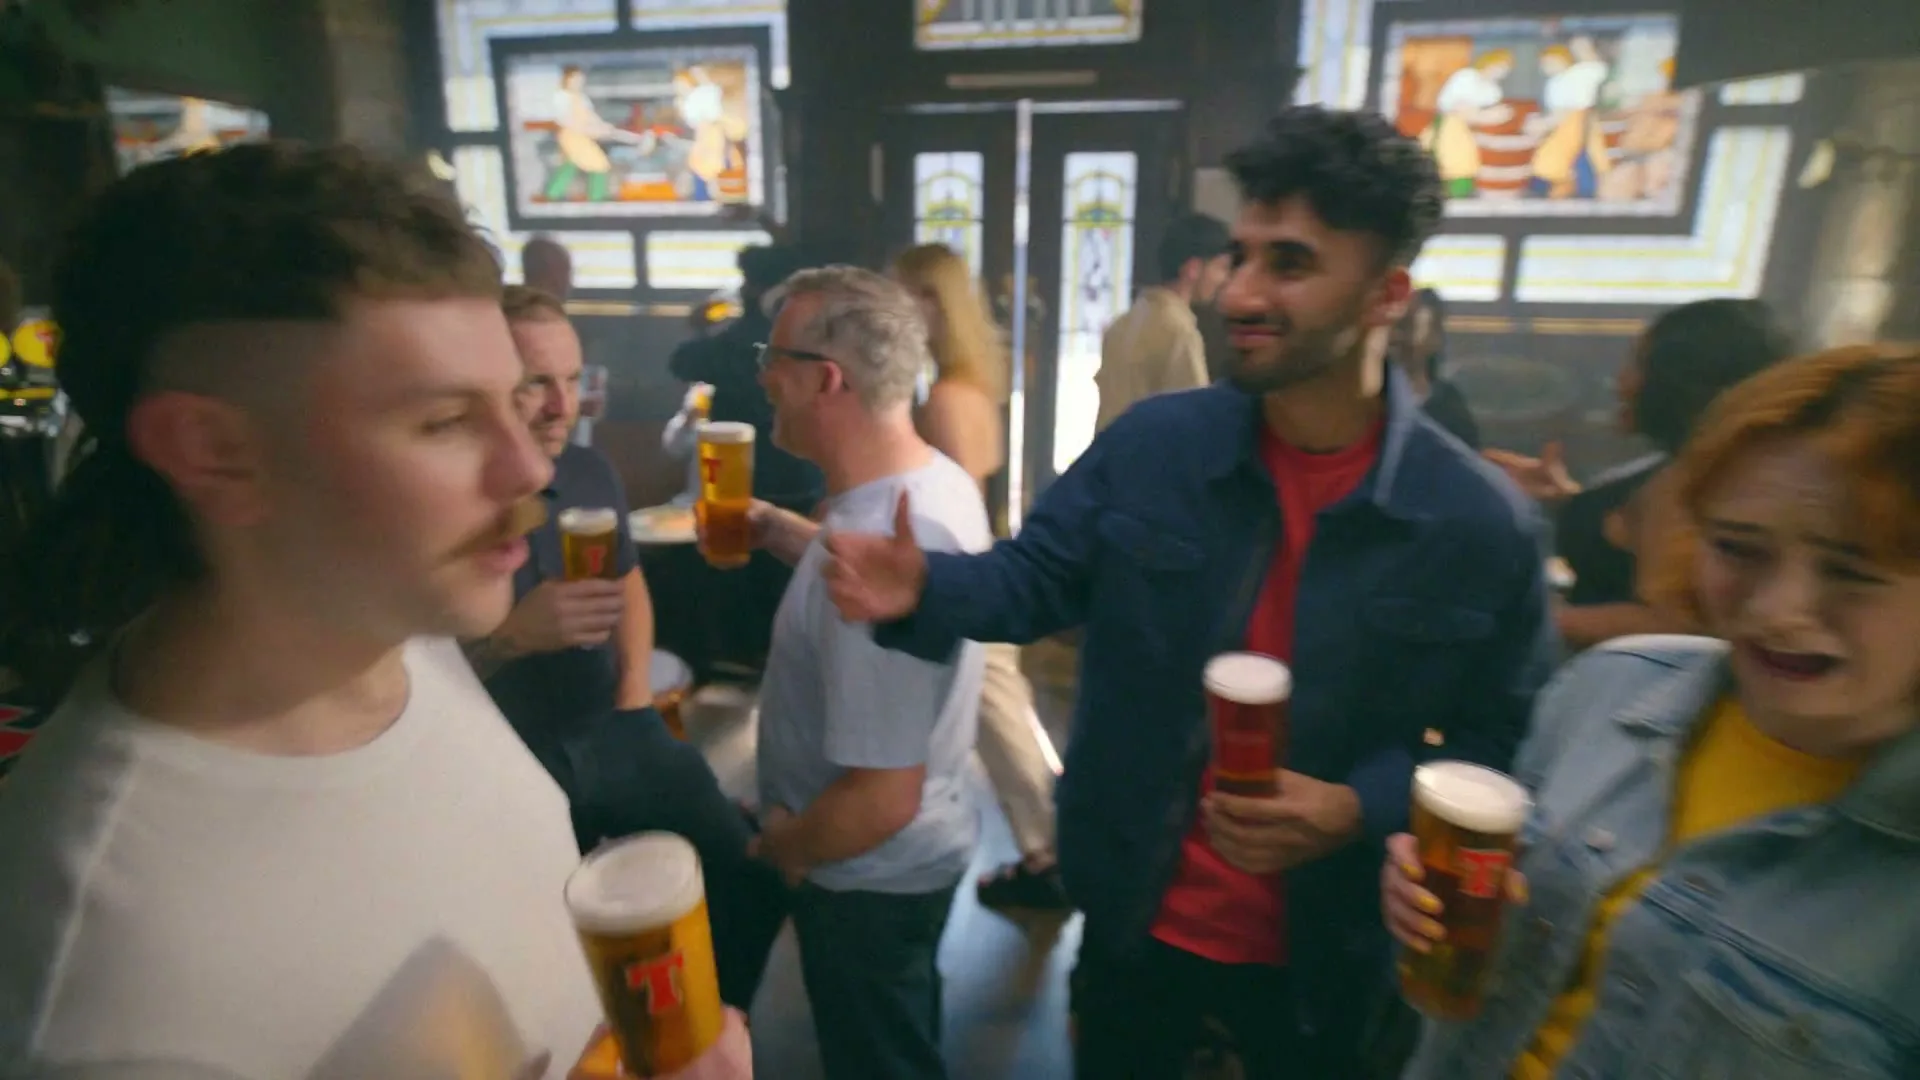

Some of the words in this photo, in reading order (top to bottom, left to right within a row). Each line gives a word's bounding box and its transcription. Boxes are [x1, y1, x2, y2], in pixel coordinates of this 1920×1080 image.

[701, 458, 721, 484] T
[583, 546, 608, 575] T
[1456, 848, 1513, 897] T
[625, 950, 684, 1015] T
